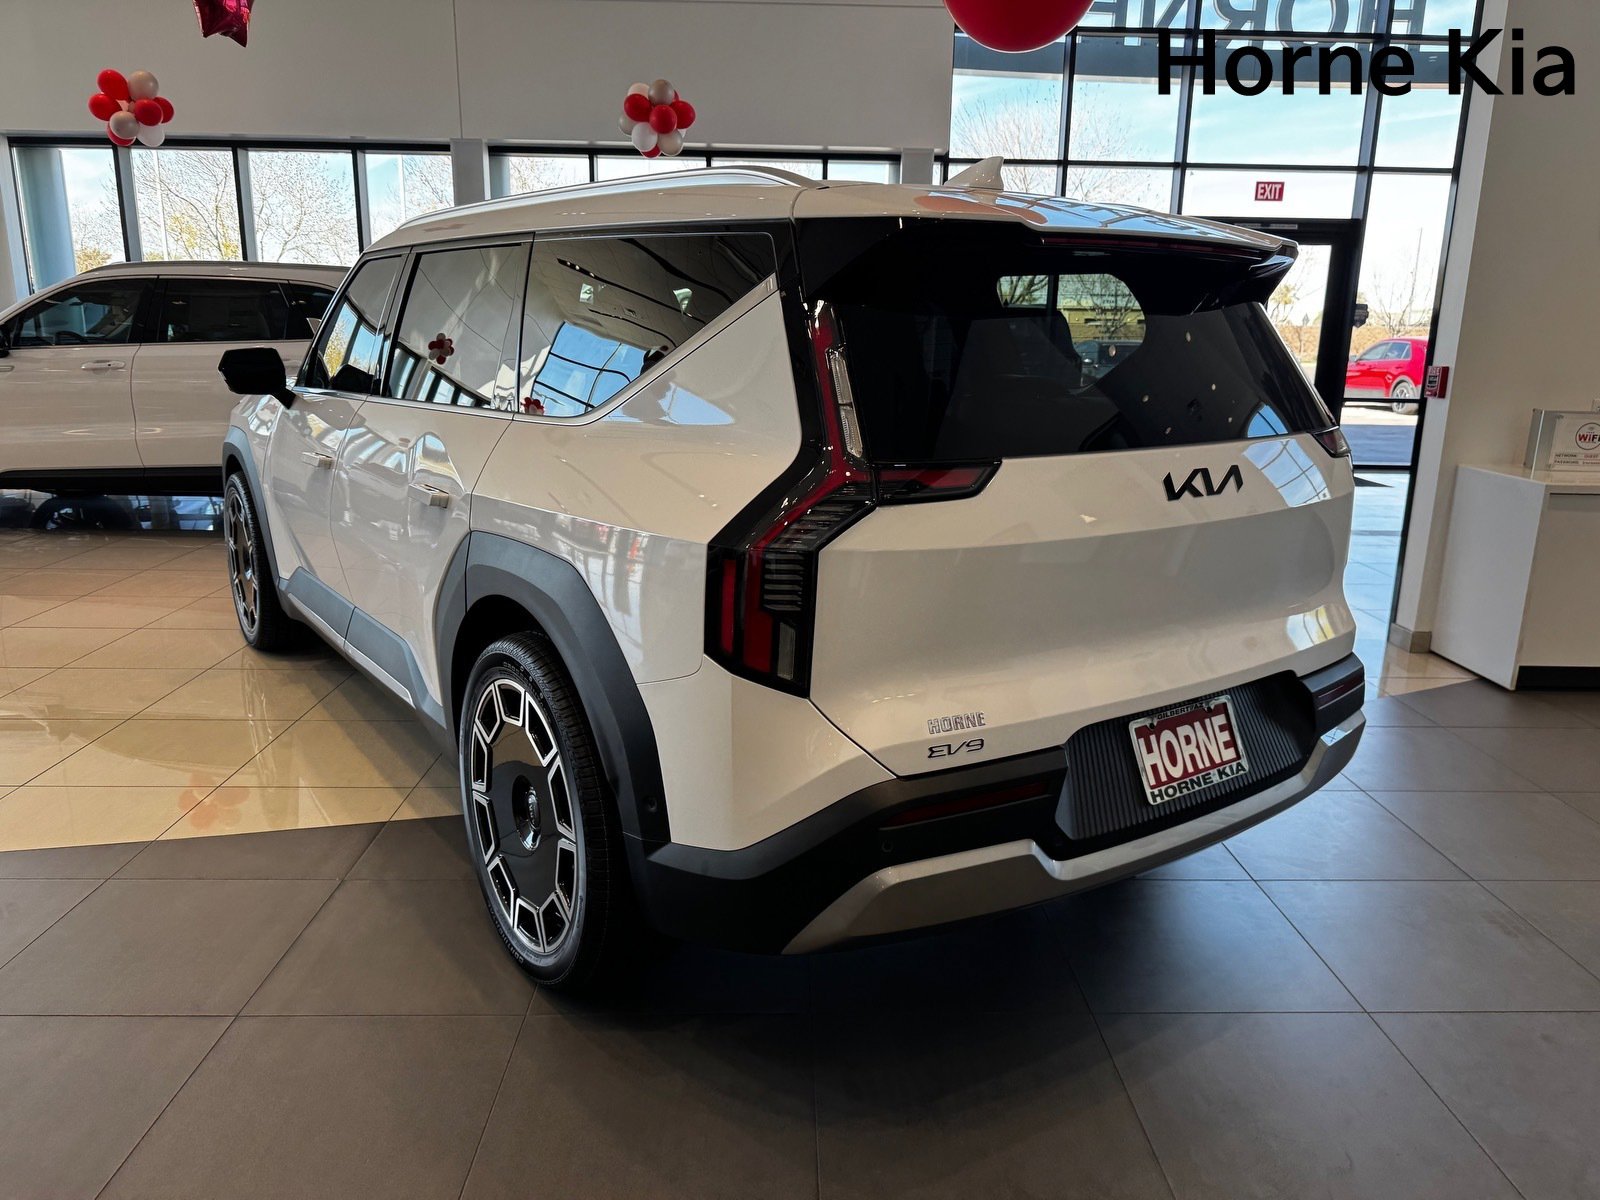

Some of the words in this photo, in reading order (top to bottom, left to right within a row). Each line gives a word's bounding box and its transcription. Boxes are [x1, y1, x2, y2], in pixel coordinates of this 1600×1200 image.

[1256, 183, 1282, 200] EXIT
[1163, 464, 1244, 501] KIA
[927, 711, 986, 734] HORNE
[927, 738, 985, 758] EV9
[1138, 713, 1237, 786] HORNE
[1150, 772, 1213, 803] HORNE
[1216, 762, 1247, 780] KIA
